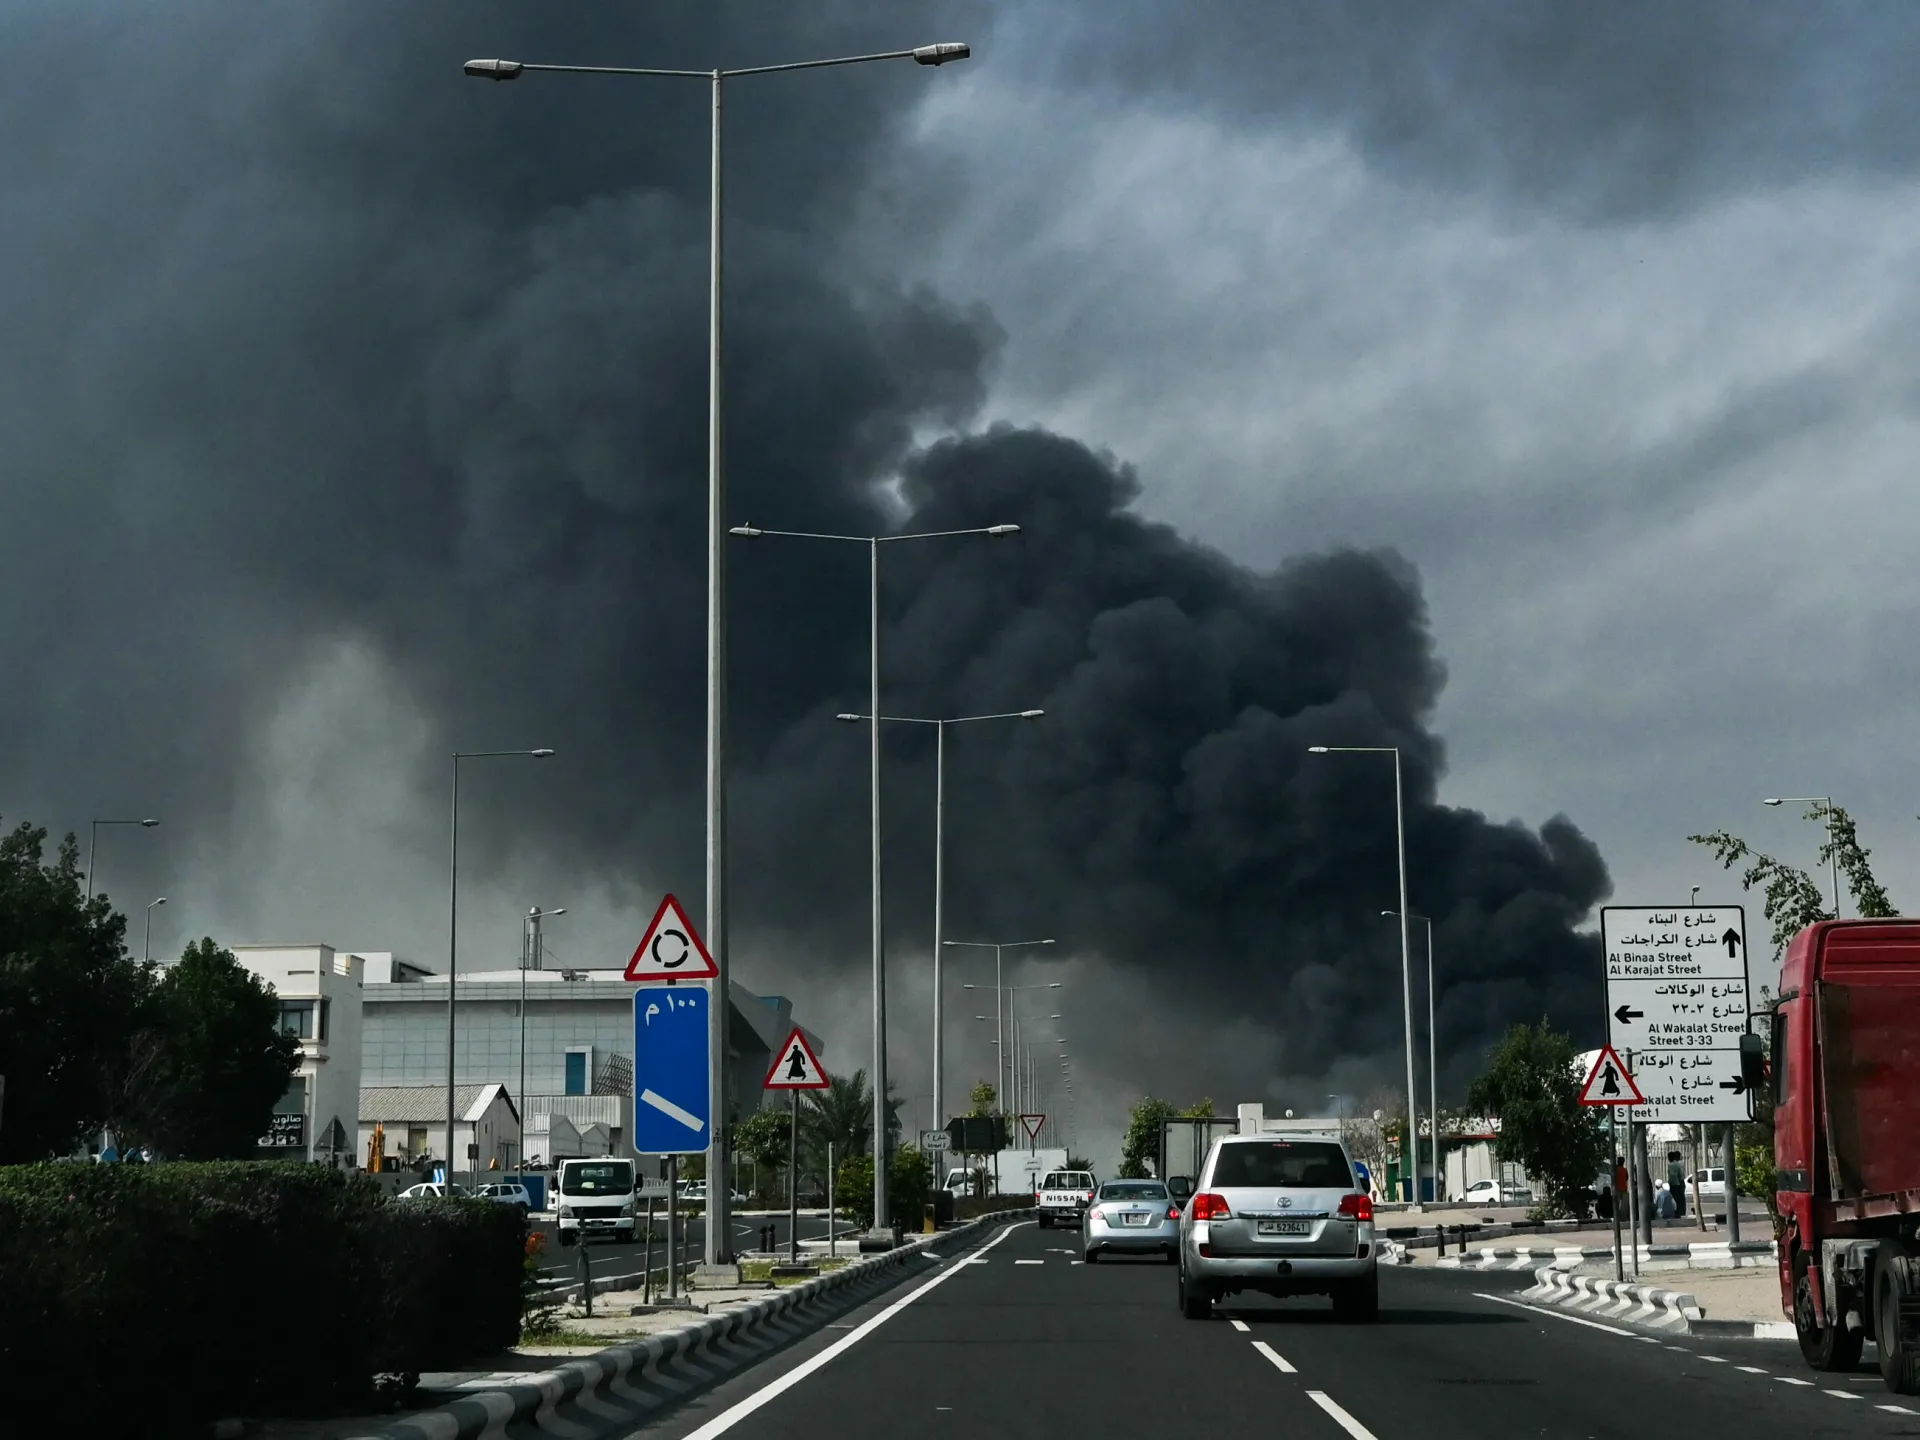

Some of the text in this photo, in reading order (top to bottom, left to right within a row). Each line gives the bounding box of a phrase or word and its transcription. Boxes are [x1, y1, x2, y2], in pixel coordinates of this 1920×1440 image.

[1649, 914, 1715, 927] شارع البناء
[1621, 934, 1717, 947] شارع الكراجات
[1610, 953, 1692, 962] Al Binaa Street
[1610, 965, 1701, 976] Al Karajat Street
[1655, 984, 1743, 998] شارع الوكالات
[667, 994, 695, 1012] ١٠٠
[1713, 1004, 1744, 1018] شارع
[1649, 1023, 1744, 1033] Al Wakalat Street
[1649, 1035, 1712, 1045] Street 3-33
[1680, 1055, 1712, 1069] شارع
[1668, 1076, 1713, 1090] شارع ١
[1643, 1095, 1714, 1104] akalat Street
[1654, 1107, 1659, 1118] 1
[1046, 1194, 1083, 1202] NISSAN
